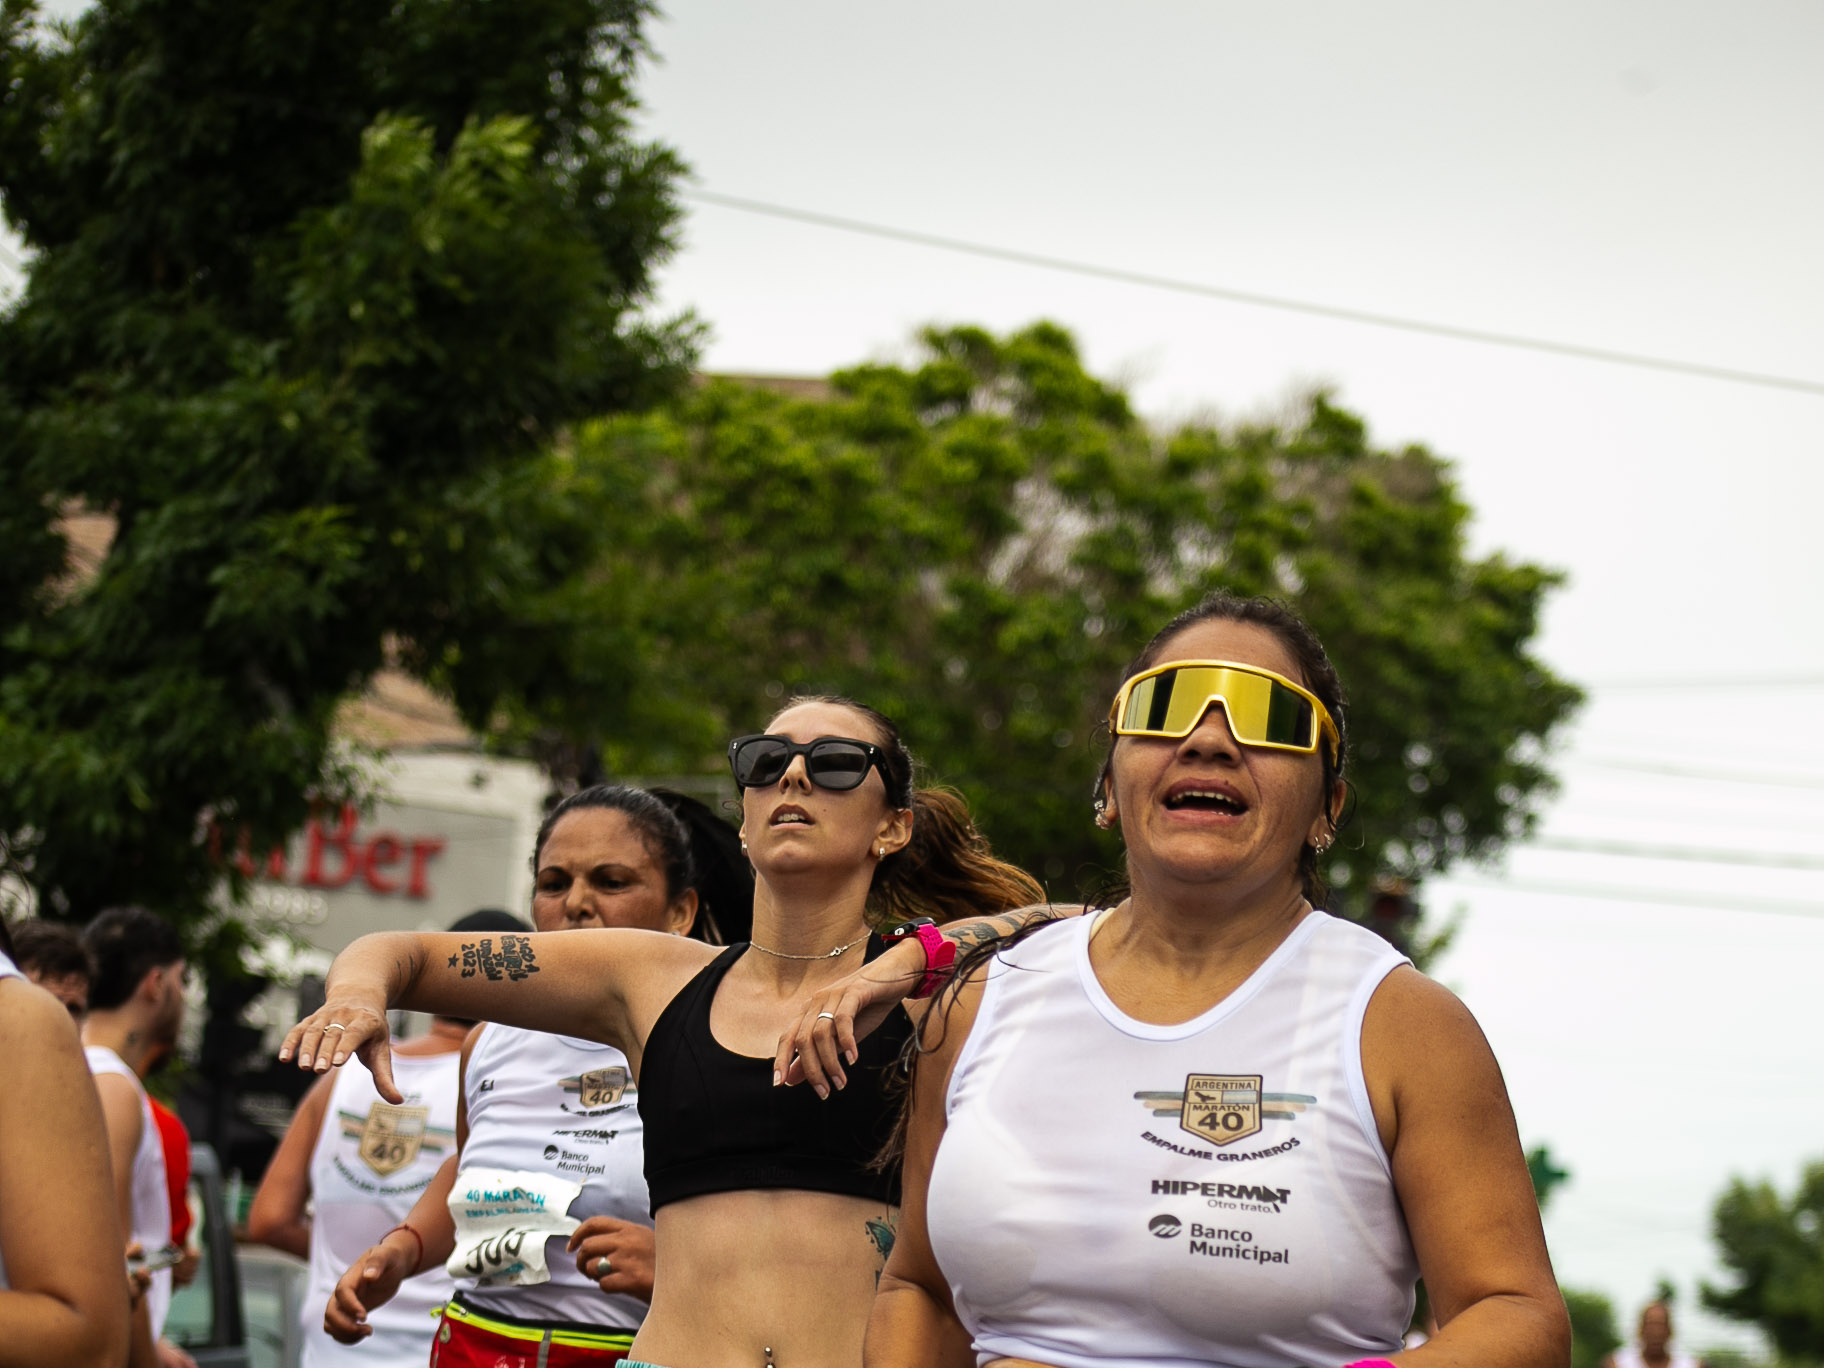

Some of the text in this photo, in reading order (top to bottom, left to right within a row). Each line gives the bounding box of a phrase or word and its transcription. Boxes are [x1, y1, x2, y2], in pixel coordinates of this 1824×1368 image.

[461, 943, 477, 979] 2023
[1194, 1081, 1253, 1091] ARGENTINA
[589, 1090, 614, 1105] 40
[1197, 1111, 1245, 1132] 40
[371, 1142, 406, 1165] 40
[561, 1149, 590, 1162] Banco
[1140, 1131, 1302, 1163] EMPALME GRANEROS
[557, 1160, 606, 1176] Municipal
[466, 1189, 480, 1202] 40
[1150, 1179, 1291, 1206] HIPERMAT
[1207, 1199, 1237, 1210] Otro
[1190, 1223, 1253, 1243] Banco
[1189, 1240, 1290, 1265] Municipal
